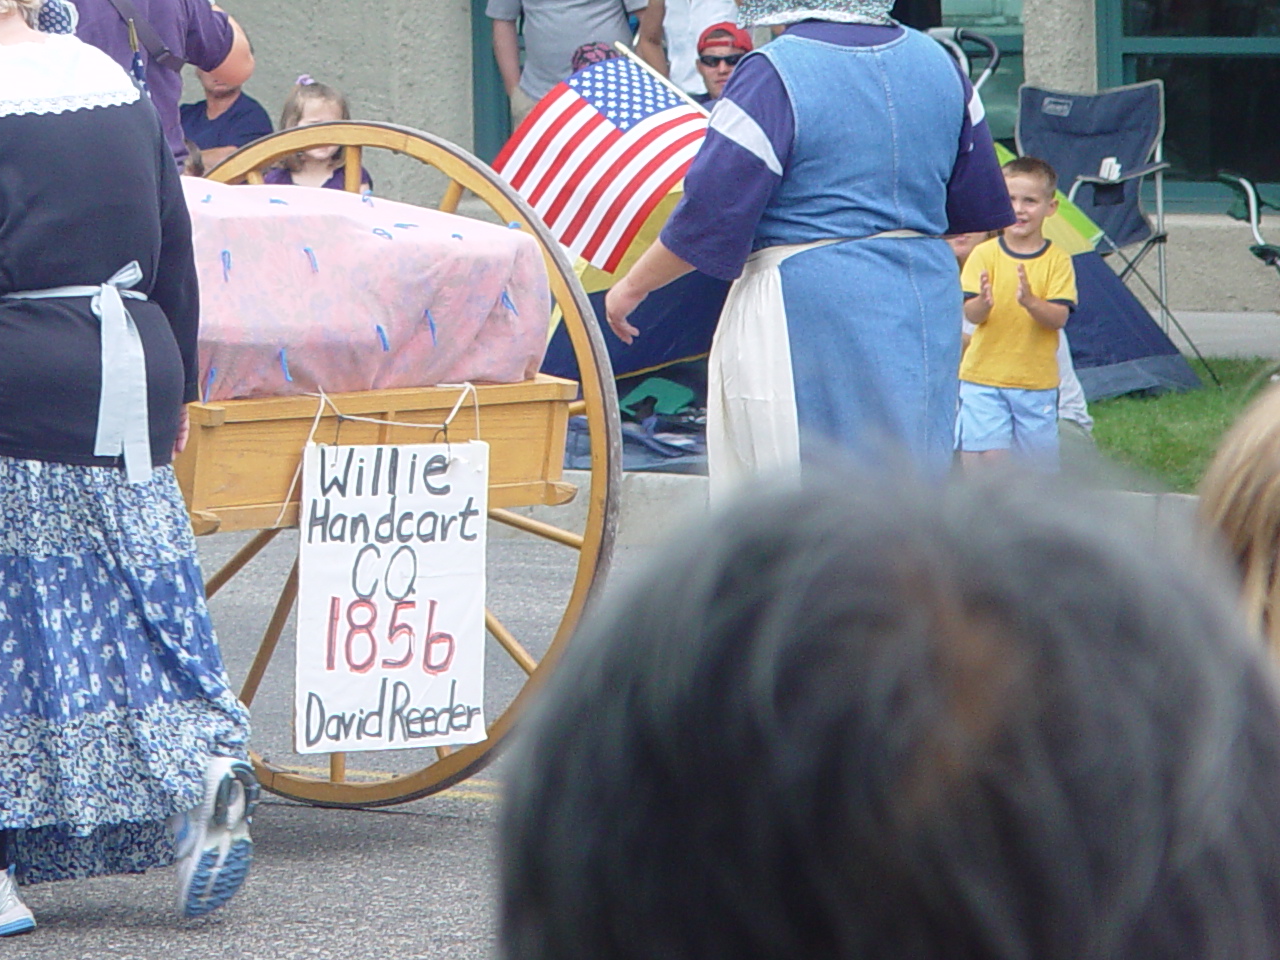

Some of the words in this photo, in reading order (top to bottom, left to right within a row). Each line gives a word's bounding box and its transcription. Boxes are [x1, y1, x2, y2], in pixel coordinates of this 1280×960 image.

[320, 447, 451, 497] Willie
[307, 495, 479, 544] Handcart
[326, 596, 455, 675] 1856
[305, 677, 388, 747] David
[389, 679, 480, 742] Reeder
